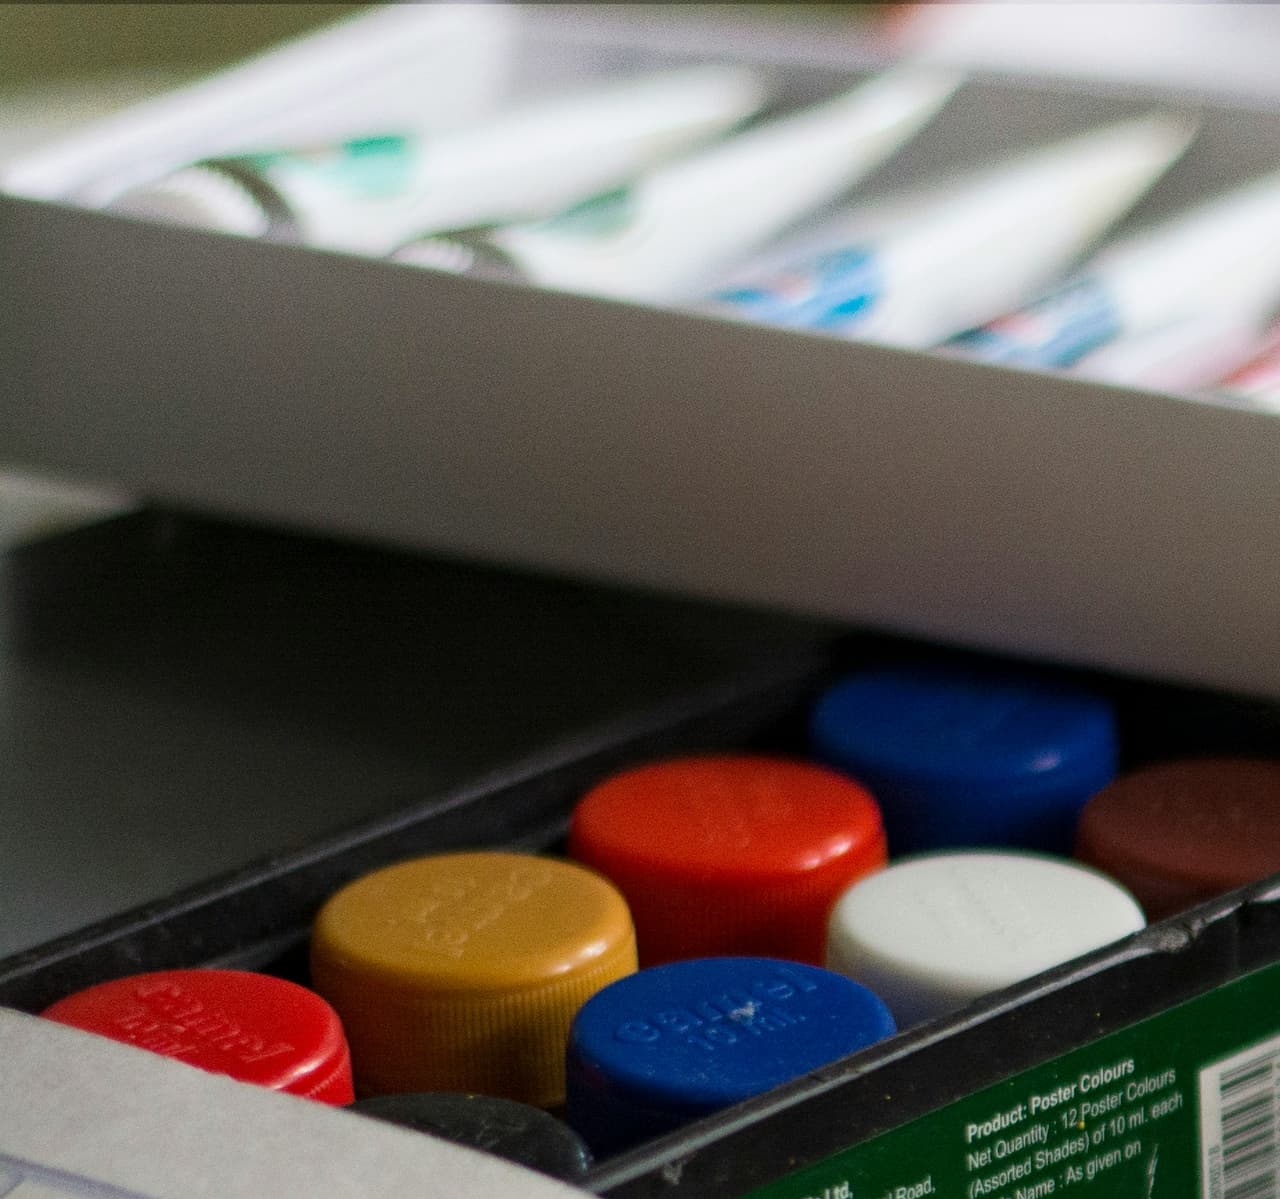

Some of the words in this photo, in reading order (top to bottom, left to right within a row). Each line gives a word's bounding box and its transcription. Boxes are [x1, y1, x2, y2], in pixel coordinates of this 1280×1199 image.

[967, 1105, 1027, 1142] Product:
[1030, 1084, 1077, 1115] Poster
[1080, 1058, 1135, 1093] Colours
[967, 1149, 992, 1171] Net
[995, 1122, 1049, 1158] Quantity
[1062, 1109, 1077, 1129] 12
[1081, 1091, 1122, 1120] Poster
[1126, 1068, 1176, 1101] Colours
[1035, 1131, 1090, 1170] Shades)
[1092, 1125, 1105, 1144] of
[1109, 1116, 1125, 1136] 10
[1151, 1092, 1183, 1119] each
[1066, 1165, 1083, 1185] As
[1086, 1150, 1122, 1180] given
[1124, 1140, 1141, 1159] on
